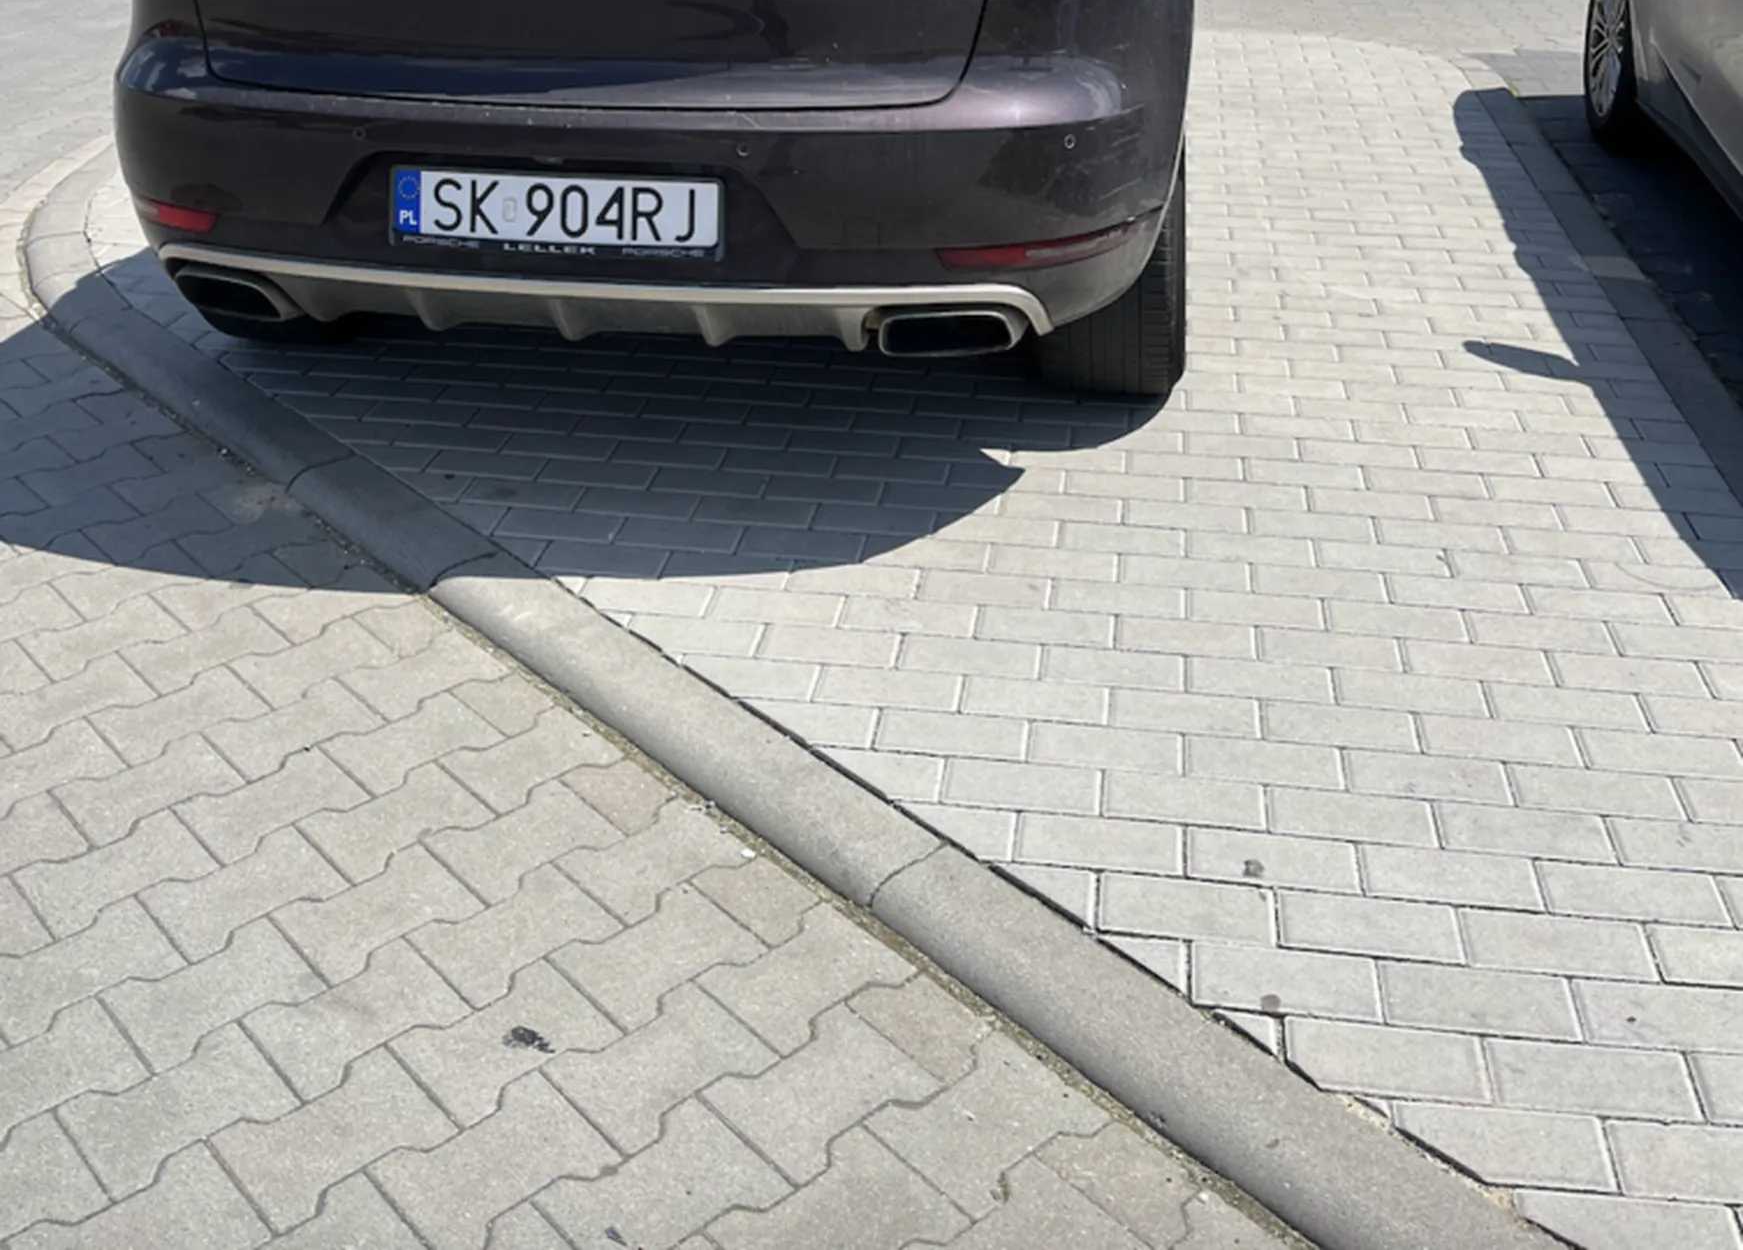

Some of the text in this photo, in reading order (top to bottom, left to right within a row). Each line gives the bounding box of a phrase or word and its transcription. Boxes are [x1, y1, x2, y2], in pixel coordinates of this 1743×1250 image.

[399, 209, 418, 226] PL
[433, 177, 697, 243] SK 904RJ
[402, 234, 481, 249] PORSCHE
[503, 243, 596, 256] LELLEK
[621, 247, 705, 259] PORSCHE
